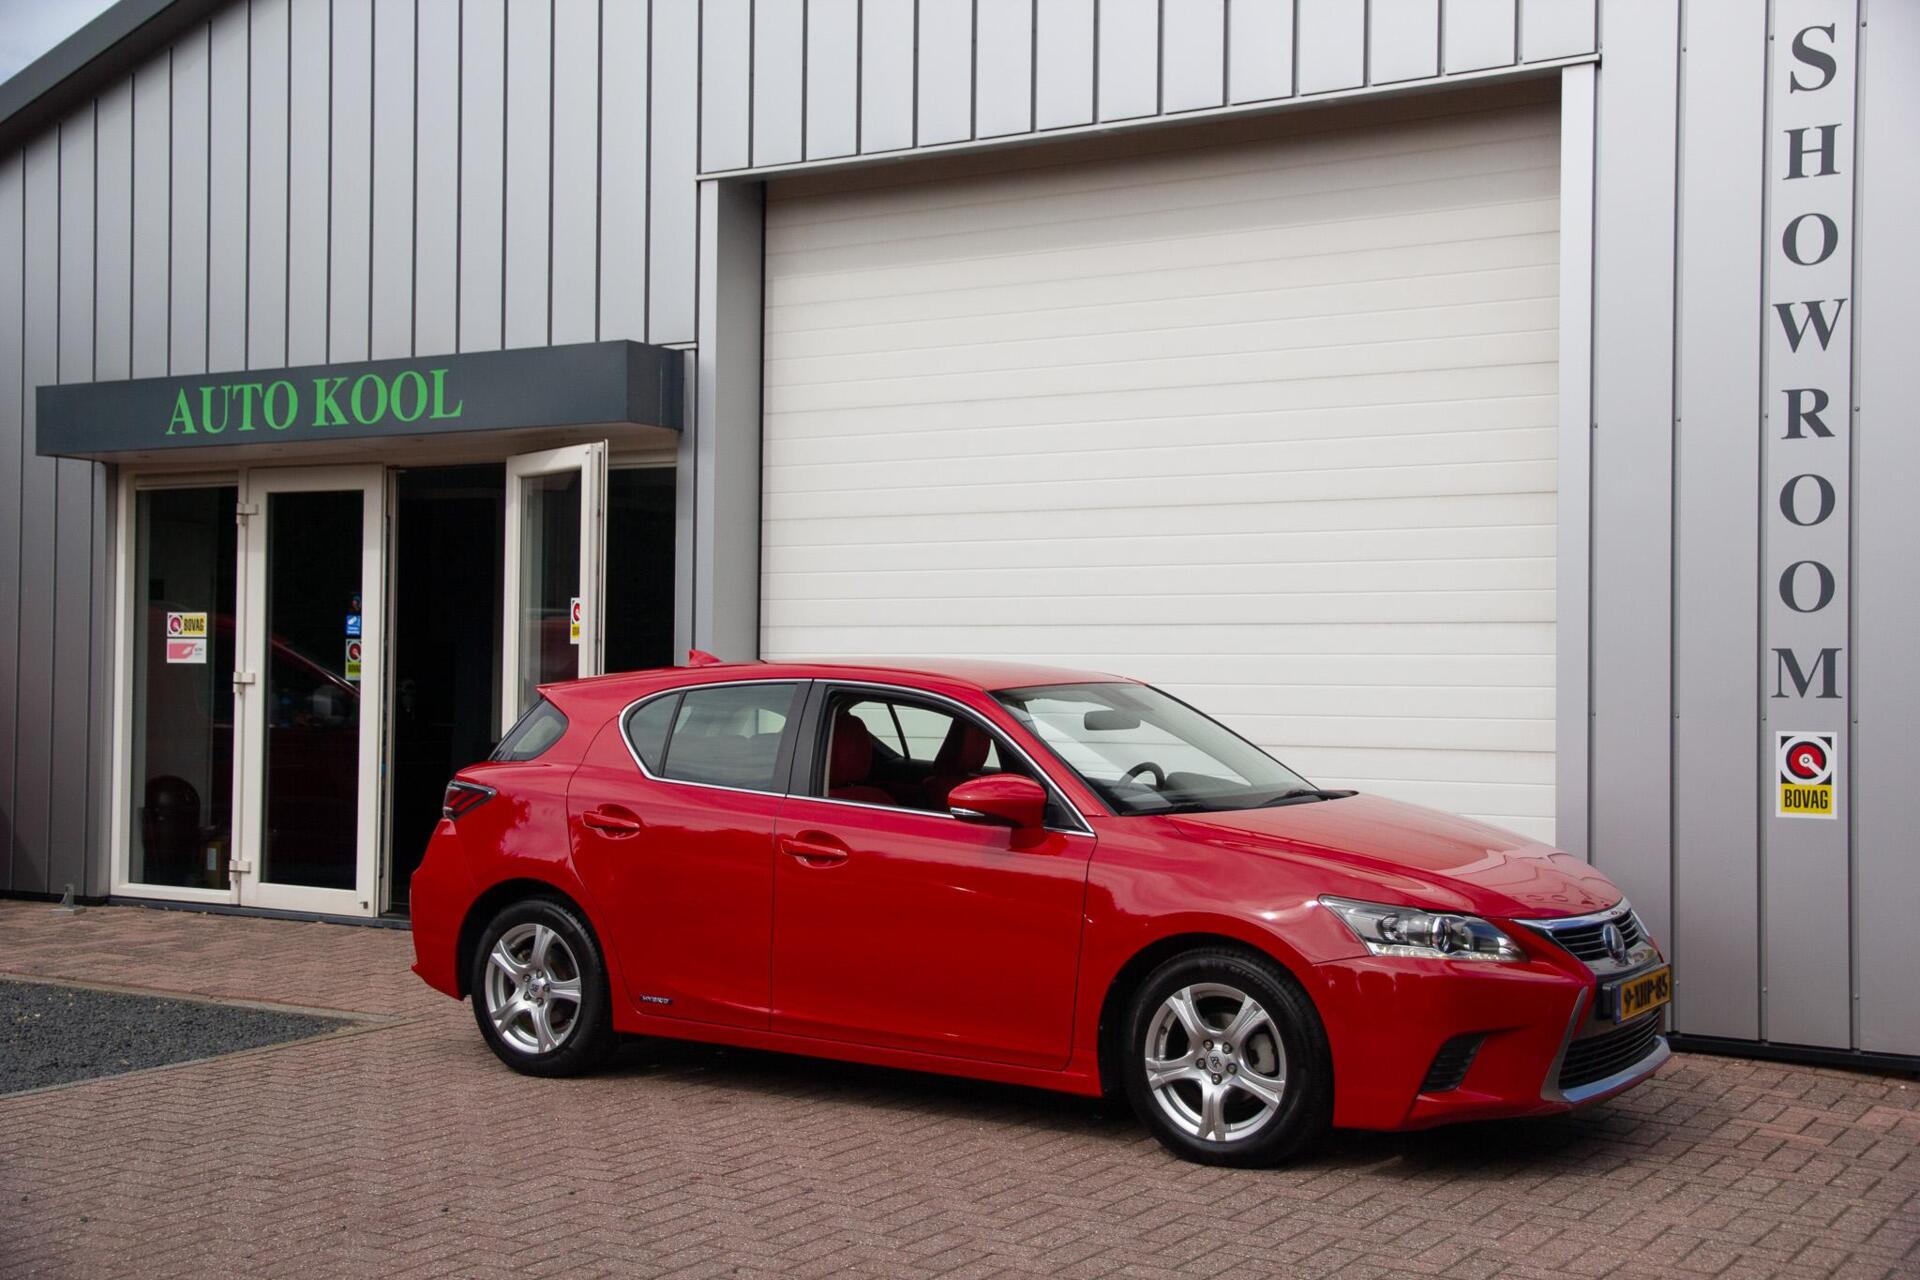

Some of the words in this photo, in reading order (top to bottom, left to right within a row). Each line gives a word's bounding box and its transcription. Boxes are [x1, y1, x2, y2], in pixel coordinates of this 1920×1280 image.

[1771, 22, 1848, 699] SHOWROOM
[165, 380, 299, 435] AUTO
[312, 368, 463, 427] KOOL
[184, 617, 205, 632] BOVAG
[1784, 788, 1829, 810] BOVAG
